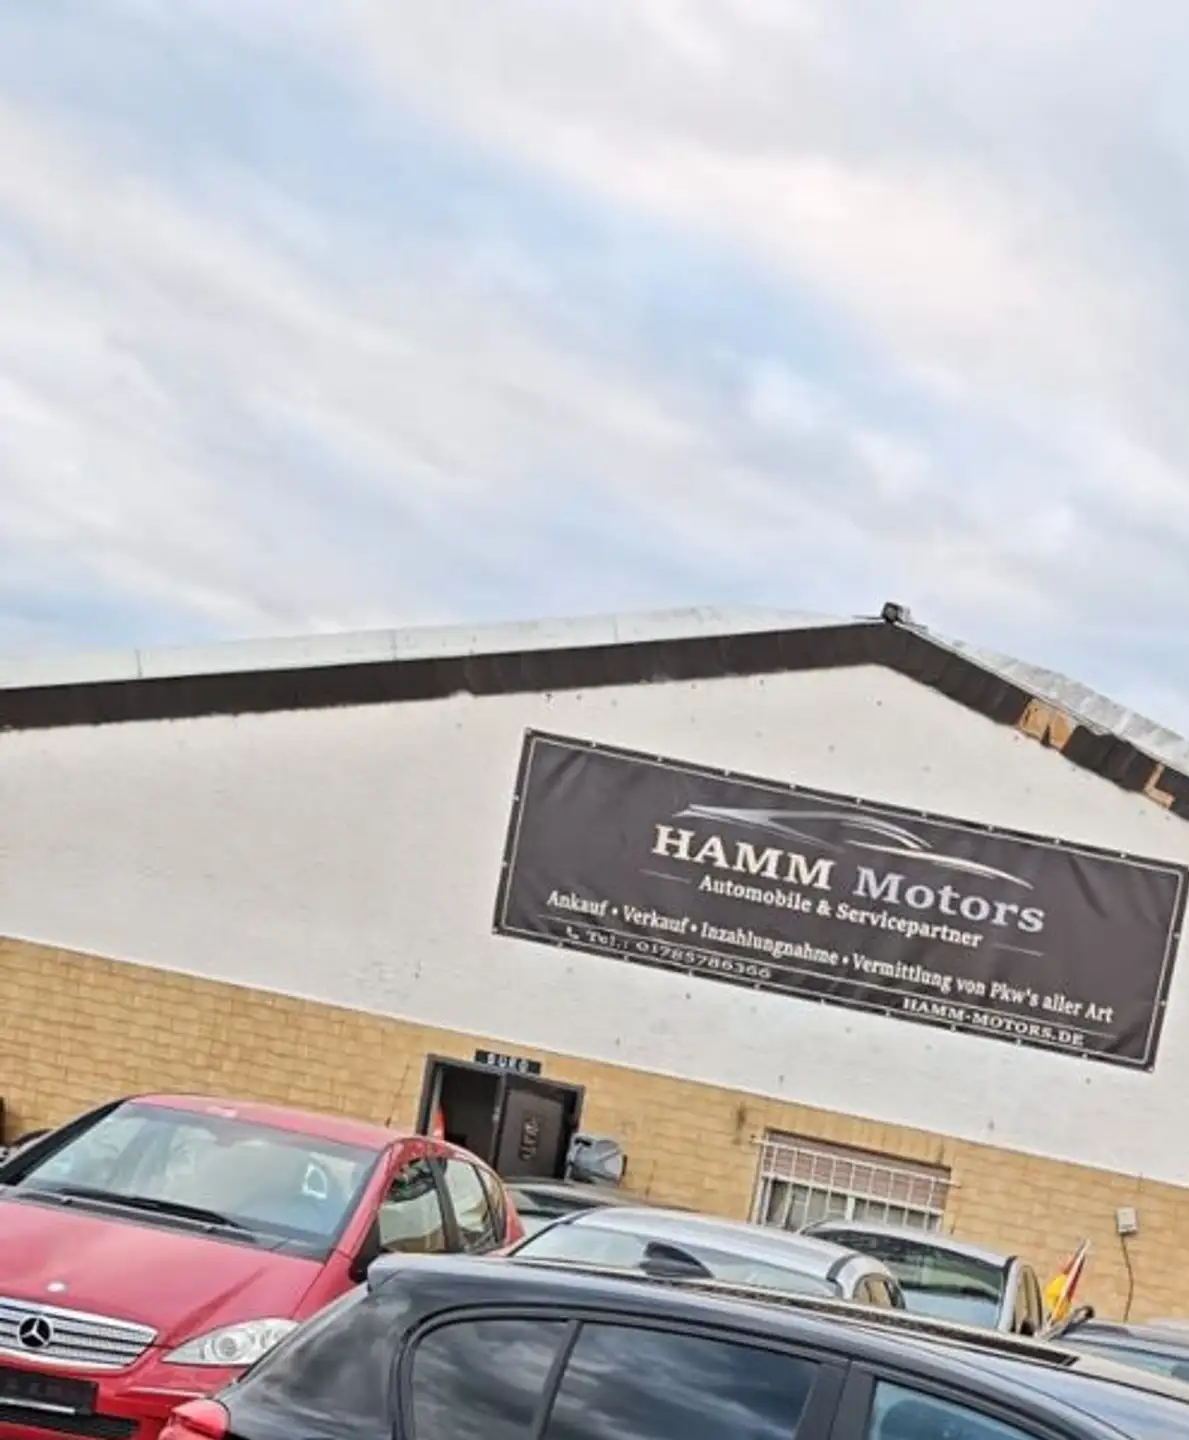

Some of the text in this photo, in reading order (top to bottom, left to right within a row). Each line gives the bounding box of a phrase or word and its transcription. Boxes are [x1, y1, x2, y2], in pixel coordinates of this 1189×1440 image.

[652, 824, 1046, 932] HAMM Motors
[698, 874, 984, 948] Automobile & Servicepartner
[546, 890, 1116, 1024] Ankauf Verkauf Inzahlungnahme Vermittlung von Pkw's aller Art
[902, 998, 1085, 1047] HAMM-MOTORS.DE
